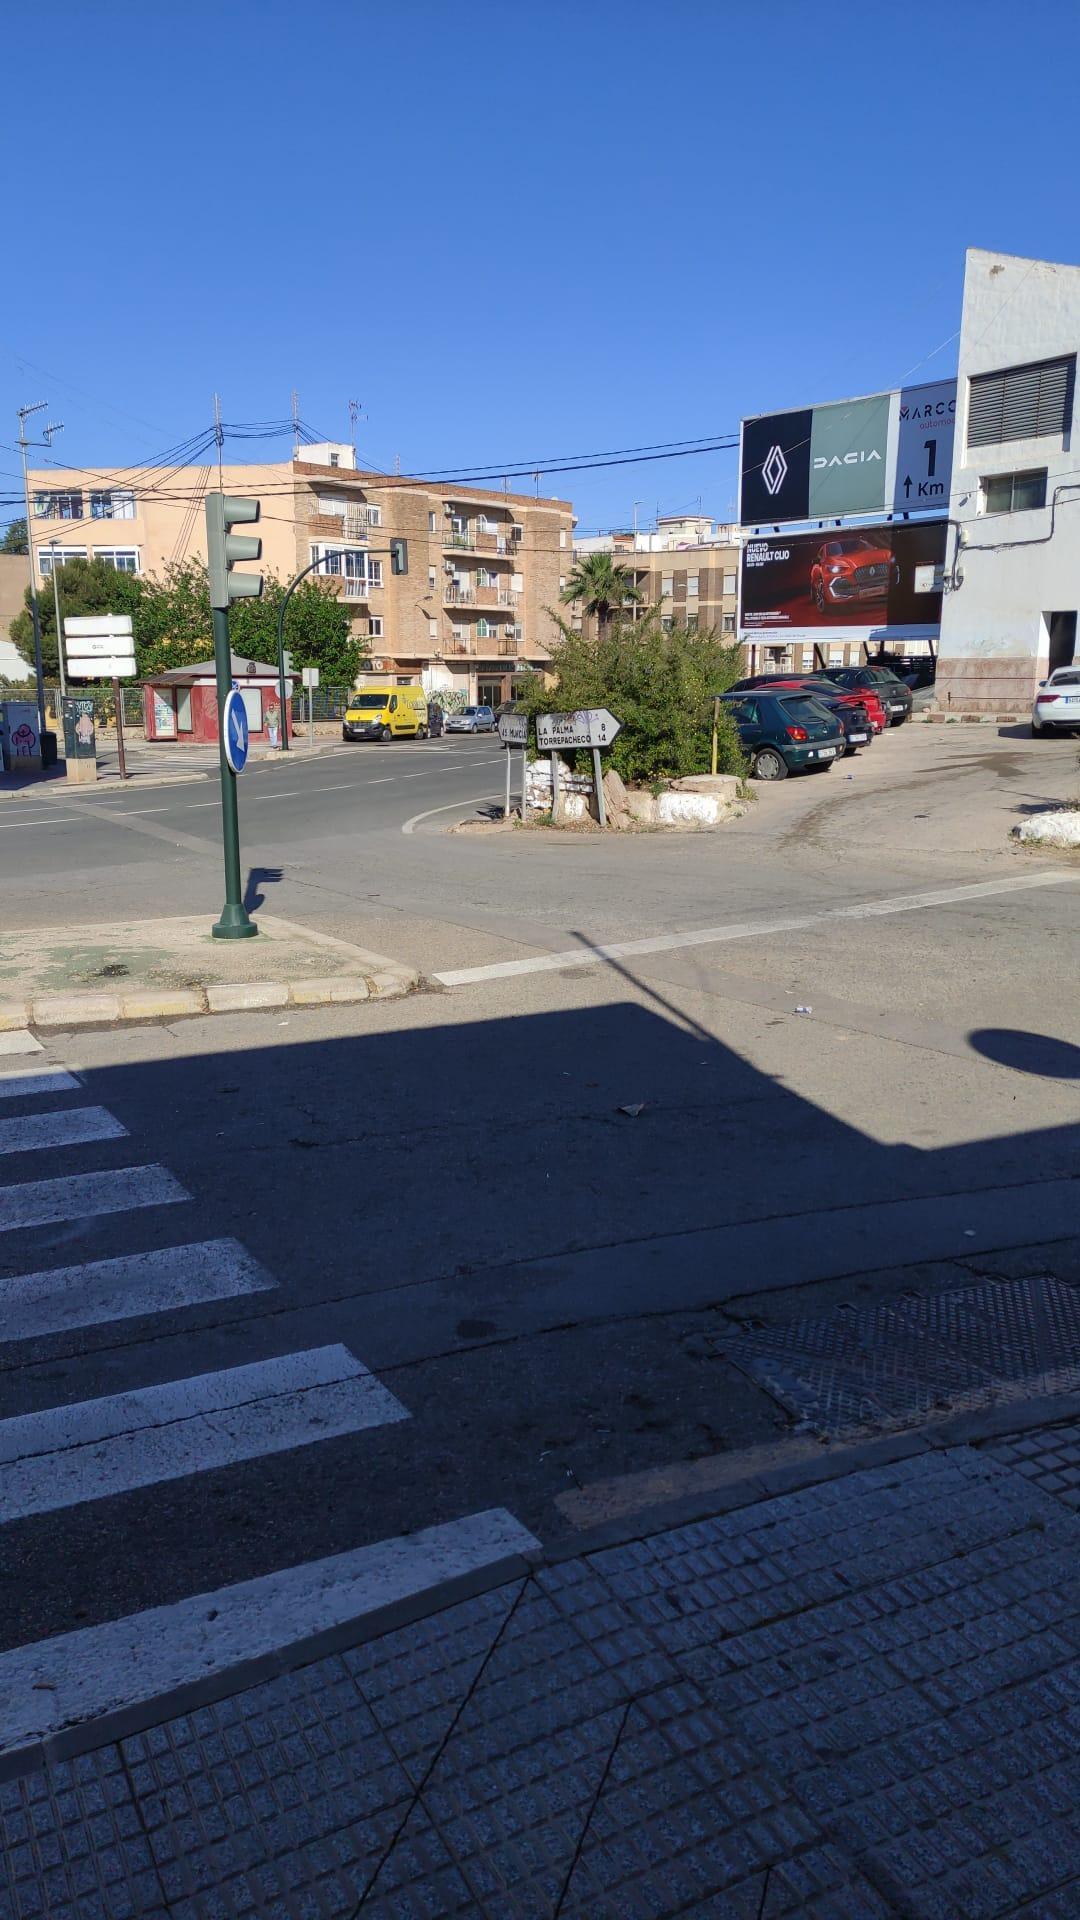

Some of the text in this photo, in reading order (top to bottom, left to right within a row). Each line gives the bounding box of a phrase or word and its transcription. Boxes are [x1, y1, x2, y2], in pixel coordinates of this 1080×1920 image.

[813, 449, 882, 469] DACIA
[924, 439, 937, 476] 1
[918, 481, 944, 497] Km
[746, 542, 768, 554] NUEVO
[746, 550, 790, 562] RENAULT CLIO
[538, 723, 606, 736] LA PALMA 8
[539, 734, 607, 746] TORREPACHECO 14
